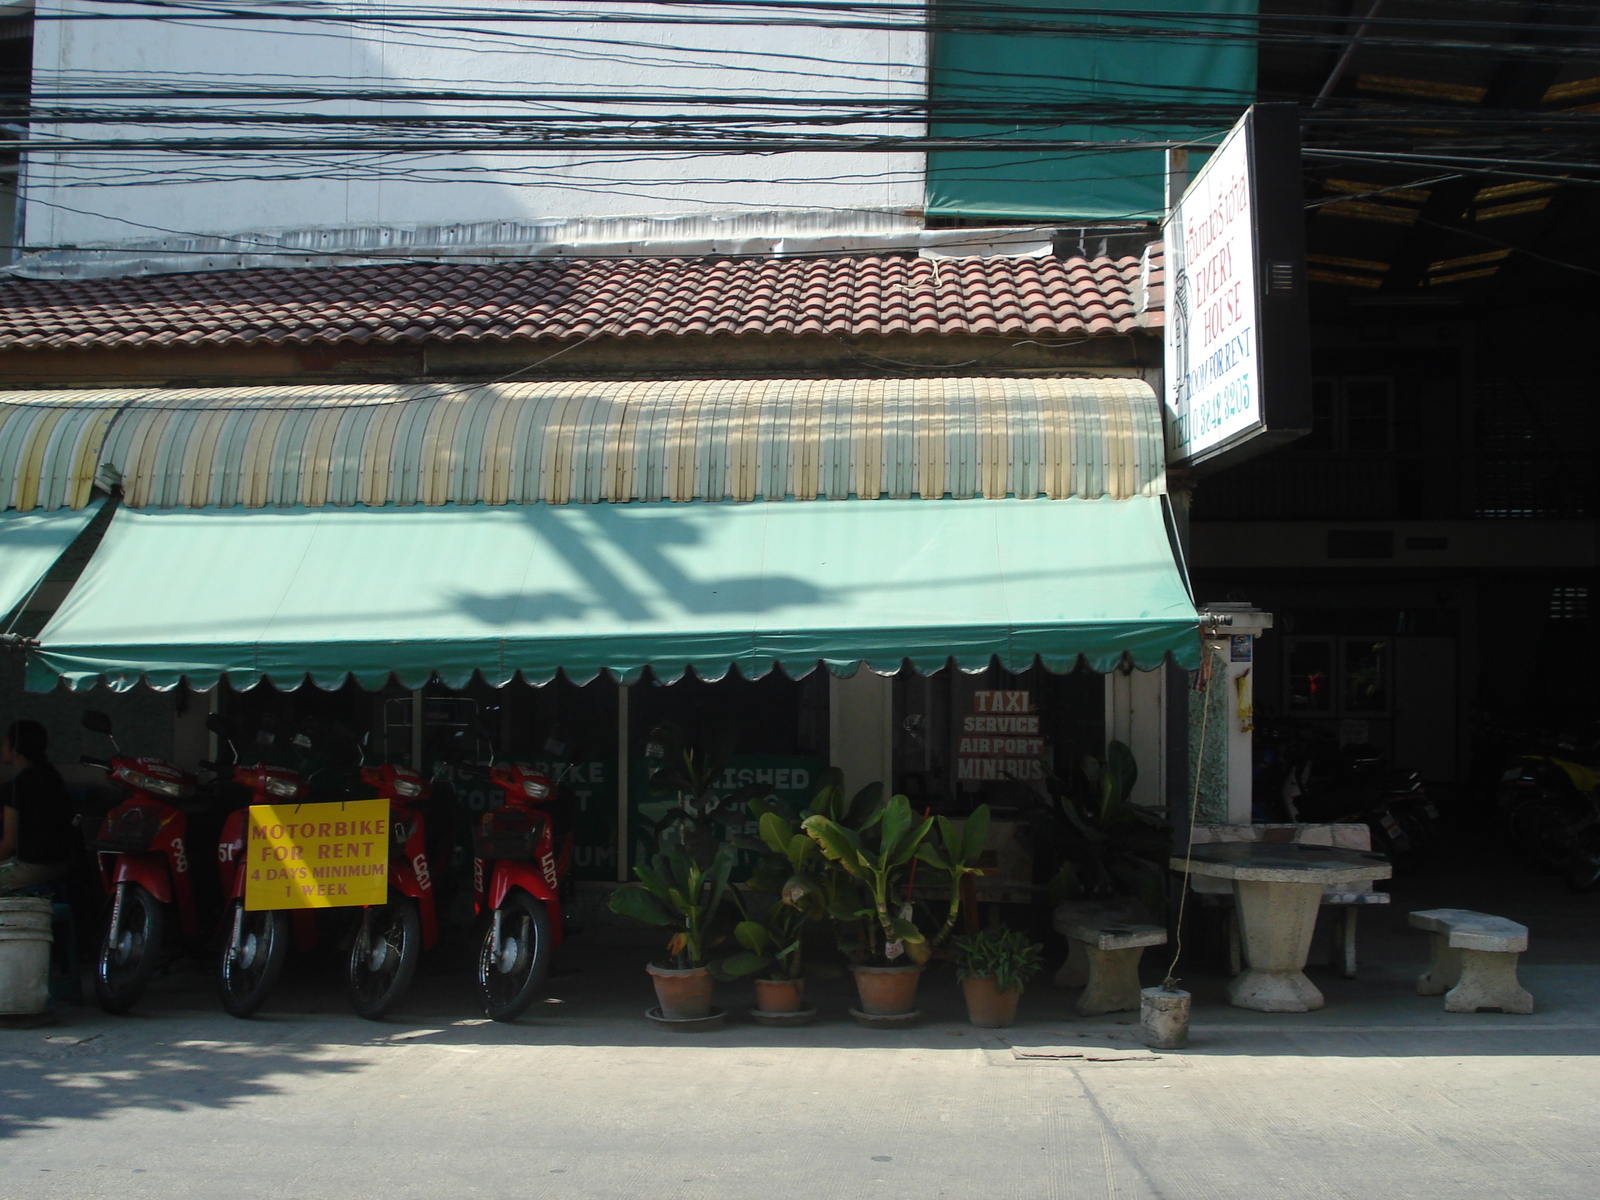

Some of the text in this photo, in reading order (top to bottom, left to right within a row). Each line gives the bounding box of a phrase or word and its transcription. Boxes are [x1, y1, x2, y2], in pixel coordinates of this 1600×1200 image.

[1196, 236, 1234, 309] EMERY
[1203, 281, 1242, 347] HOUSE
[1185, 326, 1251, 401] ROOM FOR RENT
[974, 690, 1029, 712] TAXI
[963, 716, 1039, 732] SERVICE
[960, 738, 1043, 753] AIRPORT
[957, 758, 1043, 780] MINIBUS
[252, 820, 385, 840] MOTORBIKE
[170, 837, 189, 873] 38
[261, 842, 374, 862] FOR RENT
[251, 864, 384, 881] 4 DAYS MINIMUM
[285, 883, 348, 898] 1 WEEK
